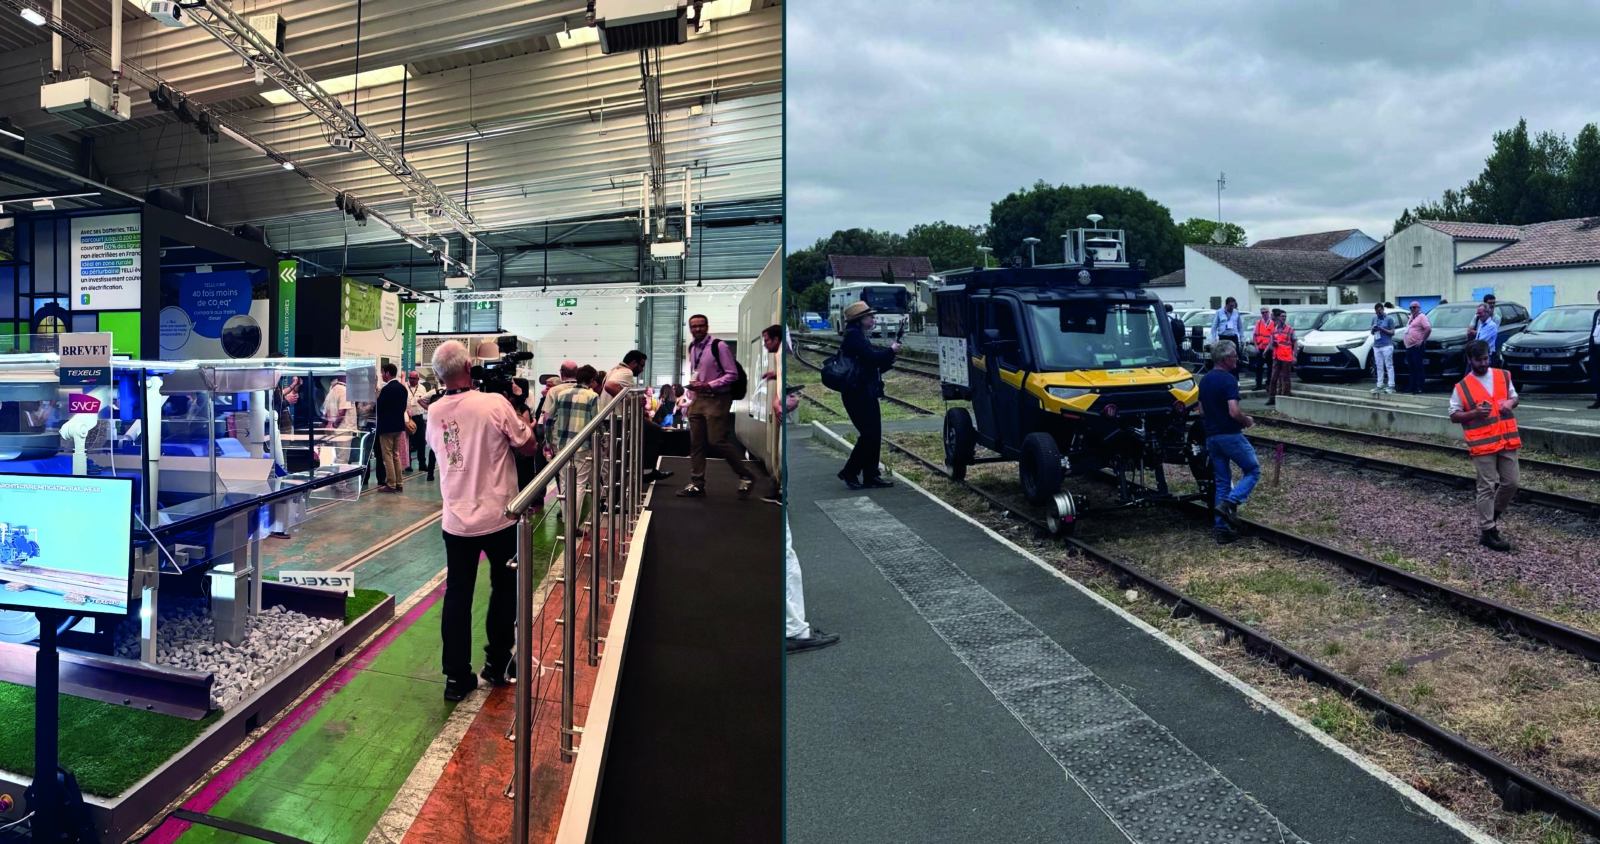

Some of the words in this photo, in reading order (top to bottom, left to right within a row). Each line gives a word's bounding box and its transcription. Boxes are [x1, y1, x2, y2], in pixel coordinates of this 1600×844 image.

[216, 288, 238, 296] moins
[62, 345, 107, 355] BREVET
[70, 401, 98, 411] SNCF
